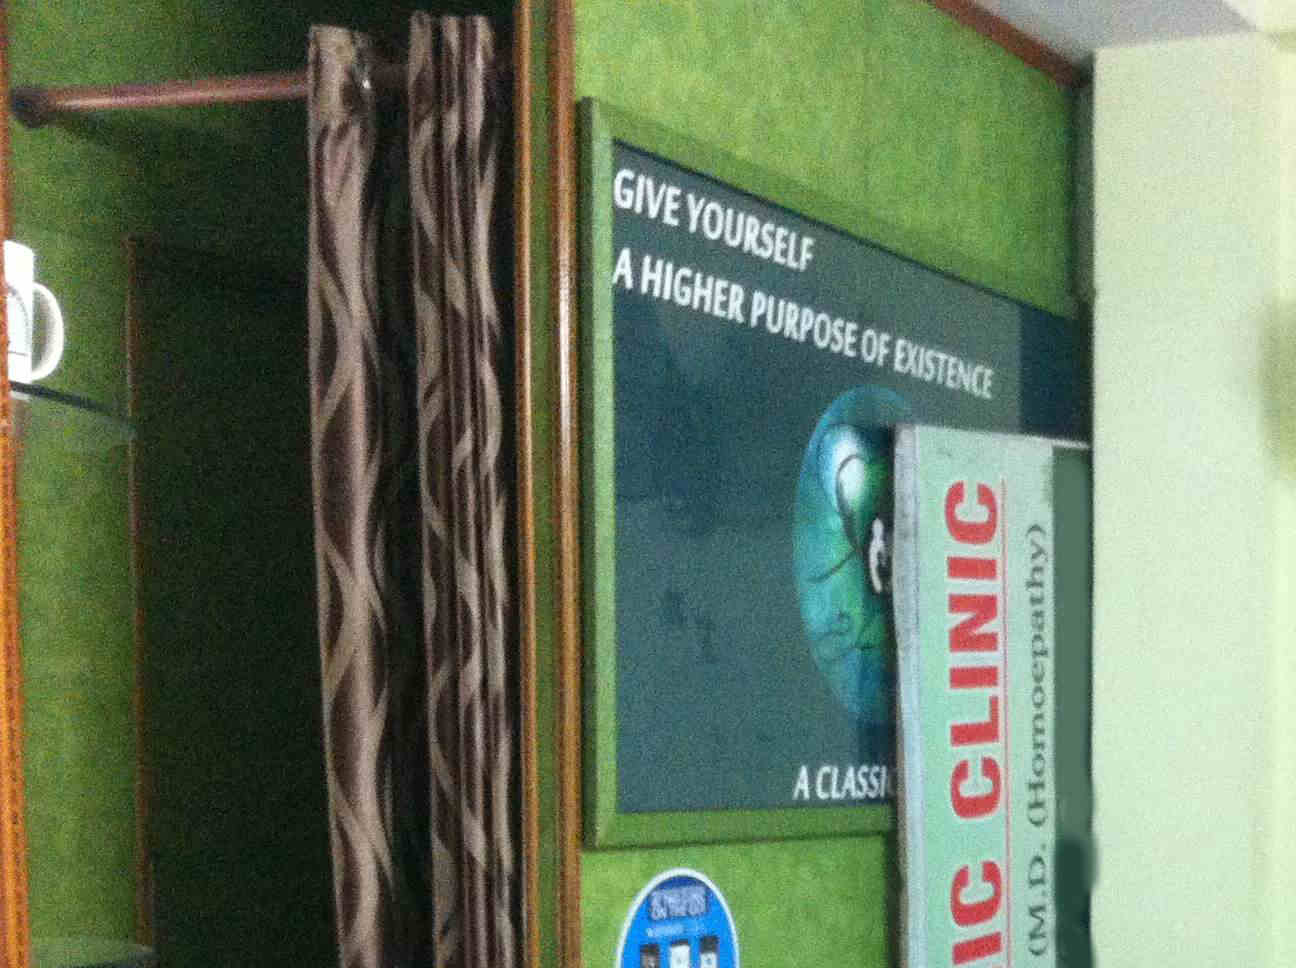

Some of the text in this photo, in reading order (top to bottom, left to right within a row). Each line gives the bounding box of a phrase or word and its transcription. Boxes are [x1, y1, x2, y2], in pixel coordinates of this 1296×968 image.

[613, 168, 816, 272] GIVE YOURSELF
[612, 247, 994, 399] A HIGHER PURPOSE OF EXISTENCE
[944, 480, 1002, 820] CLINIC
[1025, 522, 1050, 828] (Homoeopathy)
[792, 765, 810, 801] A
[1026, 830, 1049, 957] (M.D.
